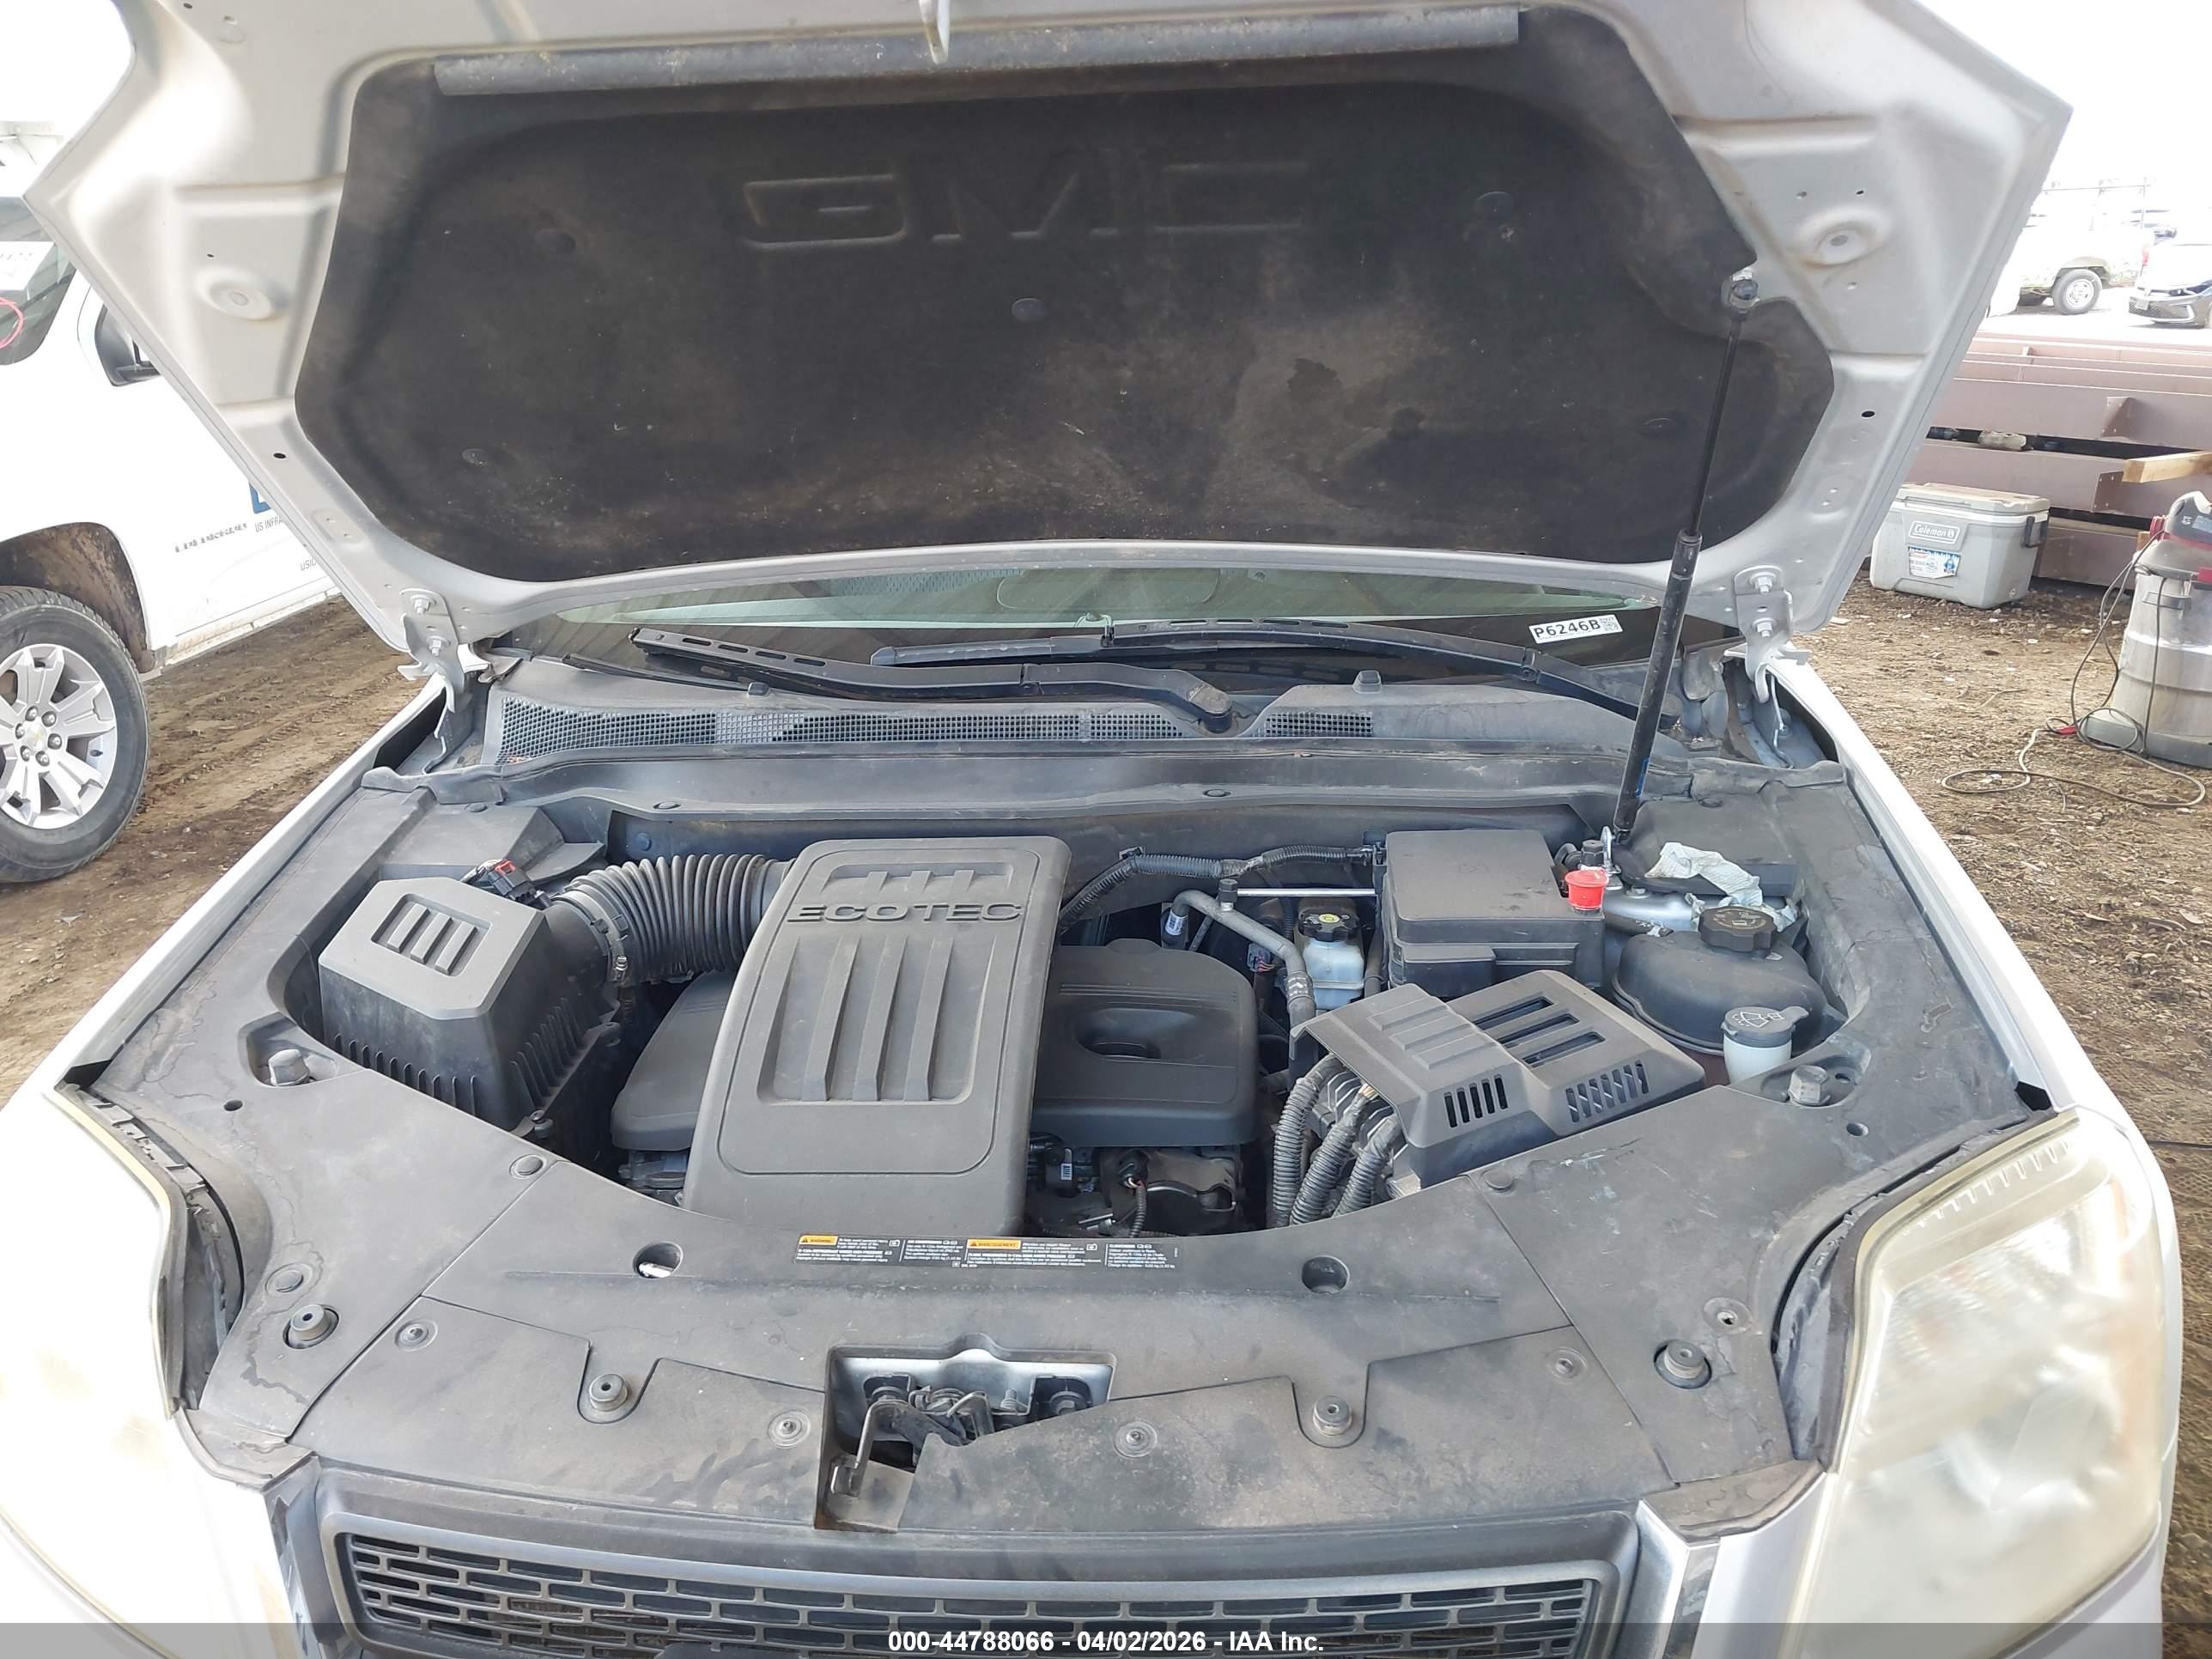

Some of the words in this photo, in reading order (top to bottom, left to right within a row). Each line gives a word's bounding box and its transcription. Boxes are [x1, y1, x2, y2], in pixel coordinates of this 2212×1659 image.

[742, 161, 1307, 251] GMC
[254, 521, 264, 532] US
[1914, 524, 1946, 538] Coleman
[1533, 619, 1601, 638] P6246B
[786, 902, 1024, 923] ECOTEC
